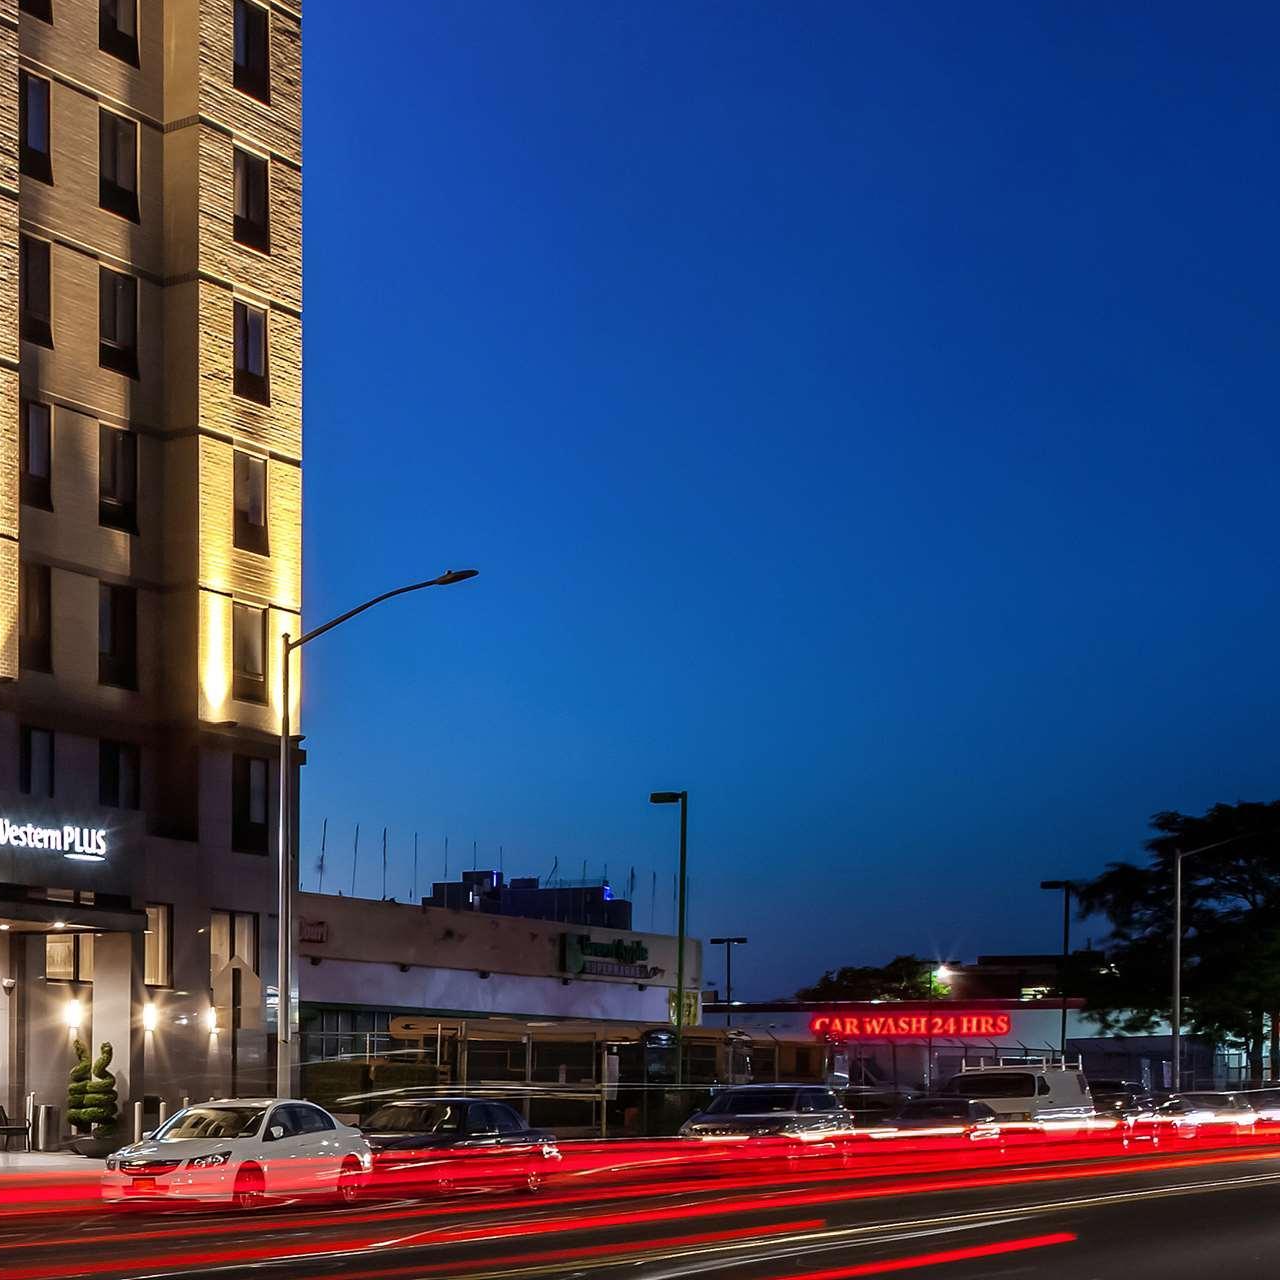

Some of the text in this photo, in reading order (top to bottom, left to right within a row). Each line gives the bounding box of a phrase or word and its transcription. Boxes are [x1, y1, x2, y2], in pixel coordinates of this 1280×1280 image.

[63, 825, 107, 855] PLUS
[814, 1015, 1009, 1035] CAR WASH 24 HRS
